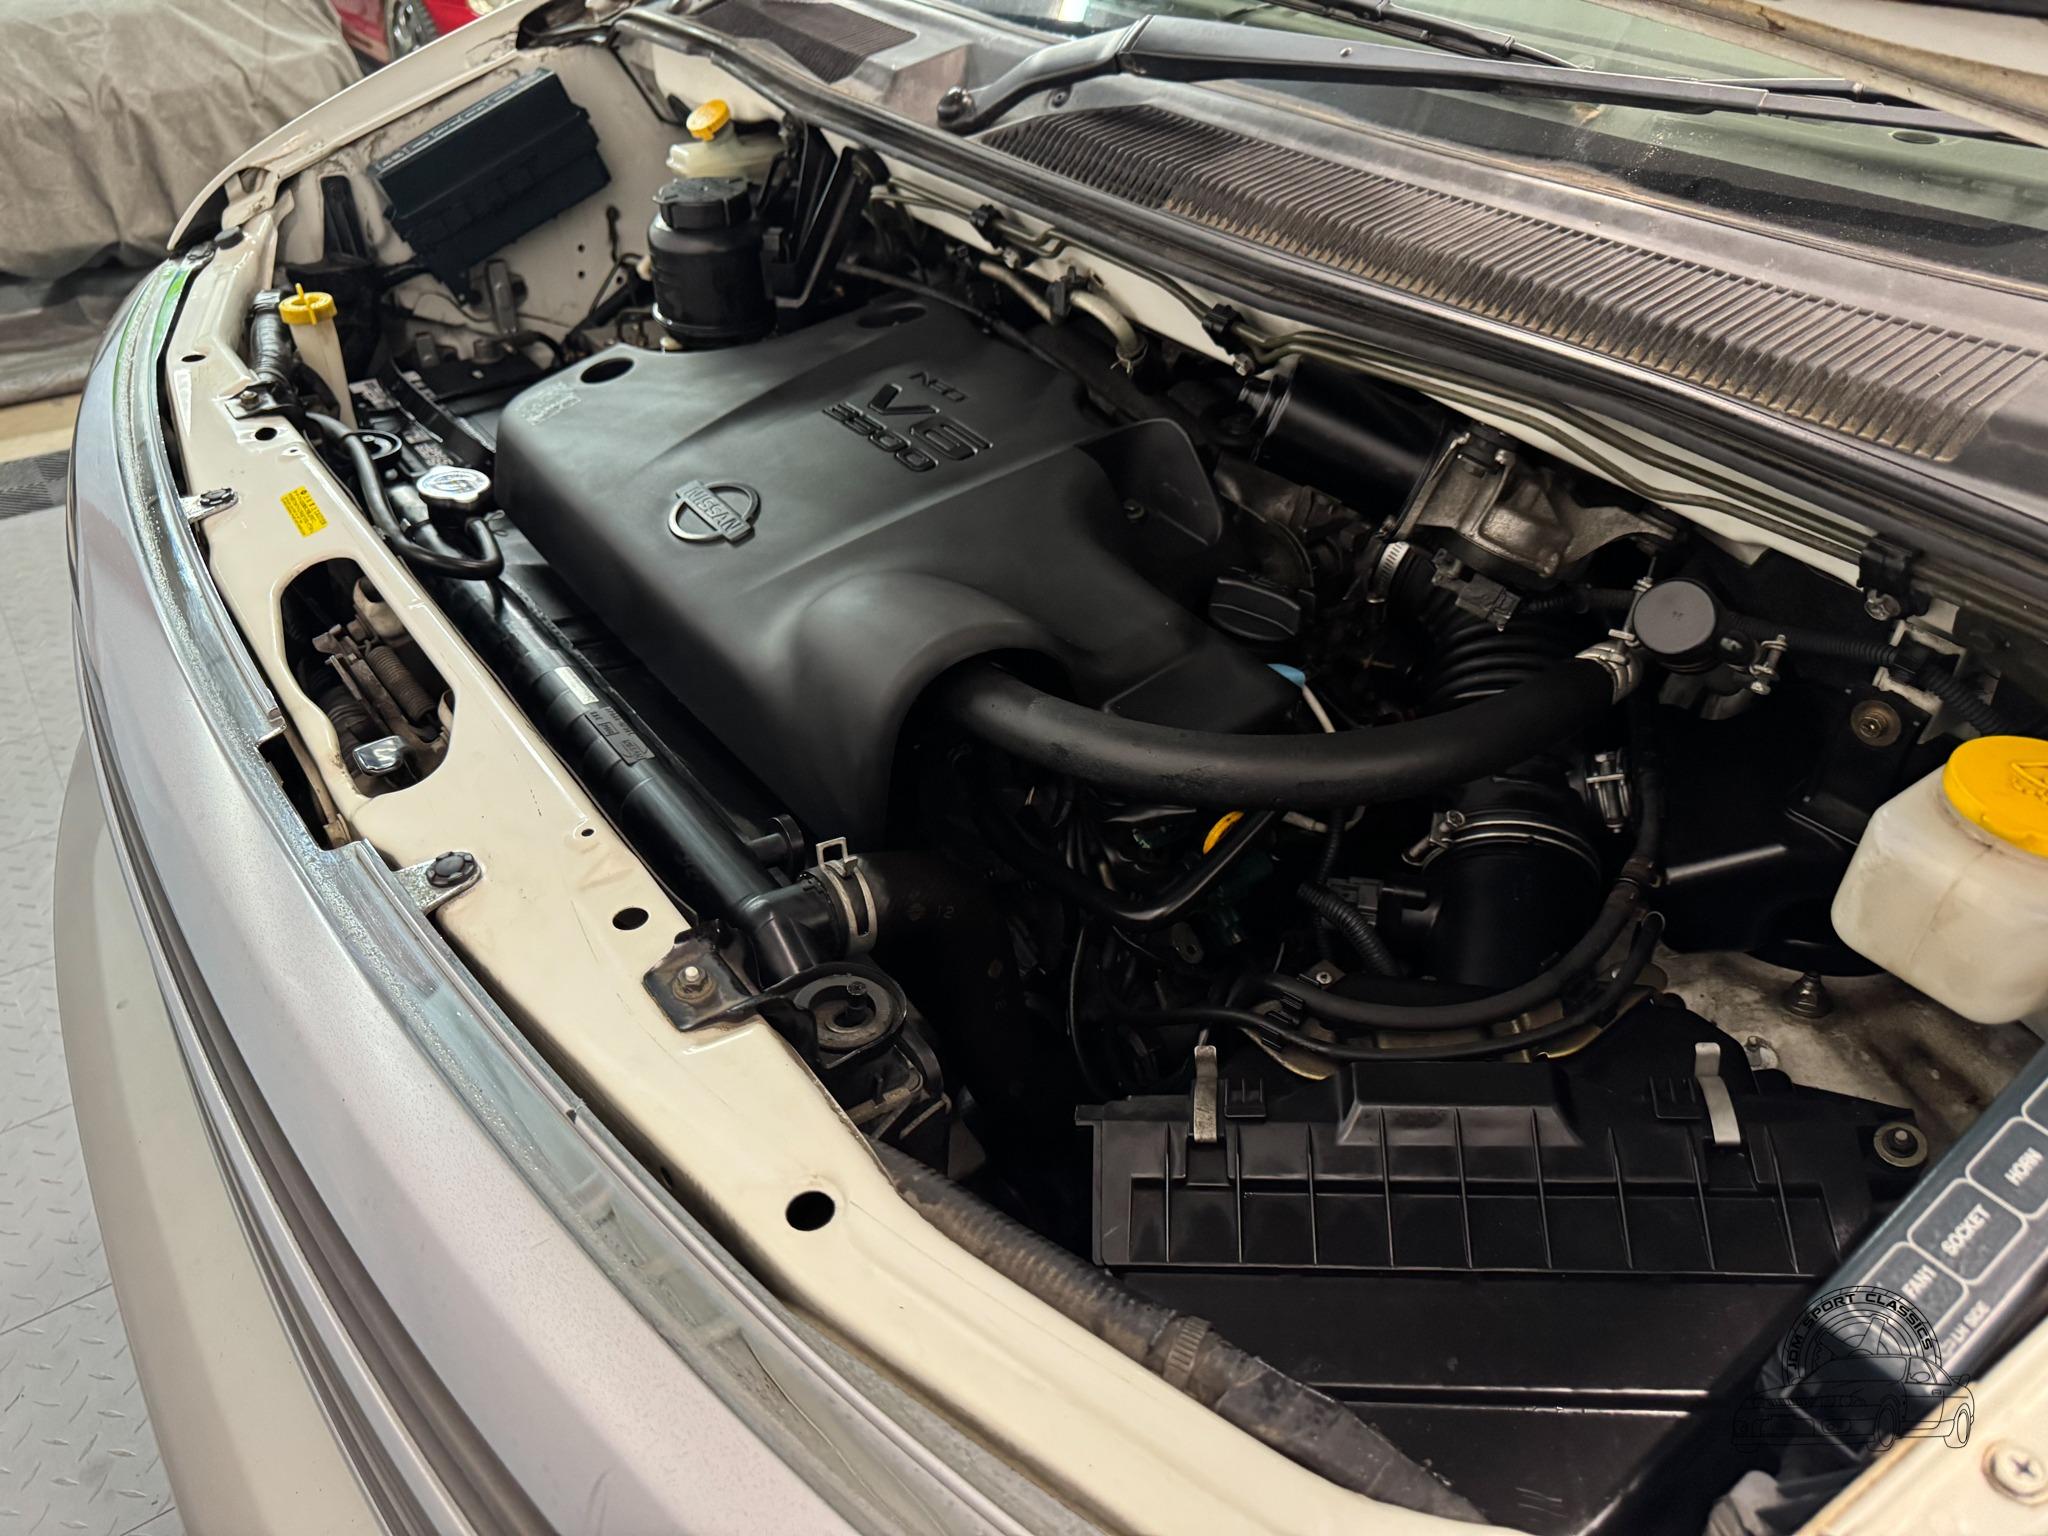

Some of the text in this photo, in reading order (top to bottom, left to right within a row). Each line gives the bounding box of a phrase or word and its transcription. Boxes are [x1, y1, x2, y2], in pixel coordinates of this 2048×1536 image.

[867, 383, 993, 461] V6
[684, 485, 742, 534] NISSAN
[2004, 1147, 2044, 1187] HORN
[1941, 1203, 1992, 1257] SOCKET
